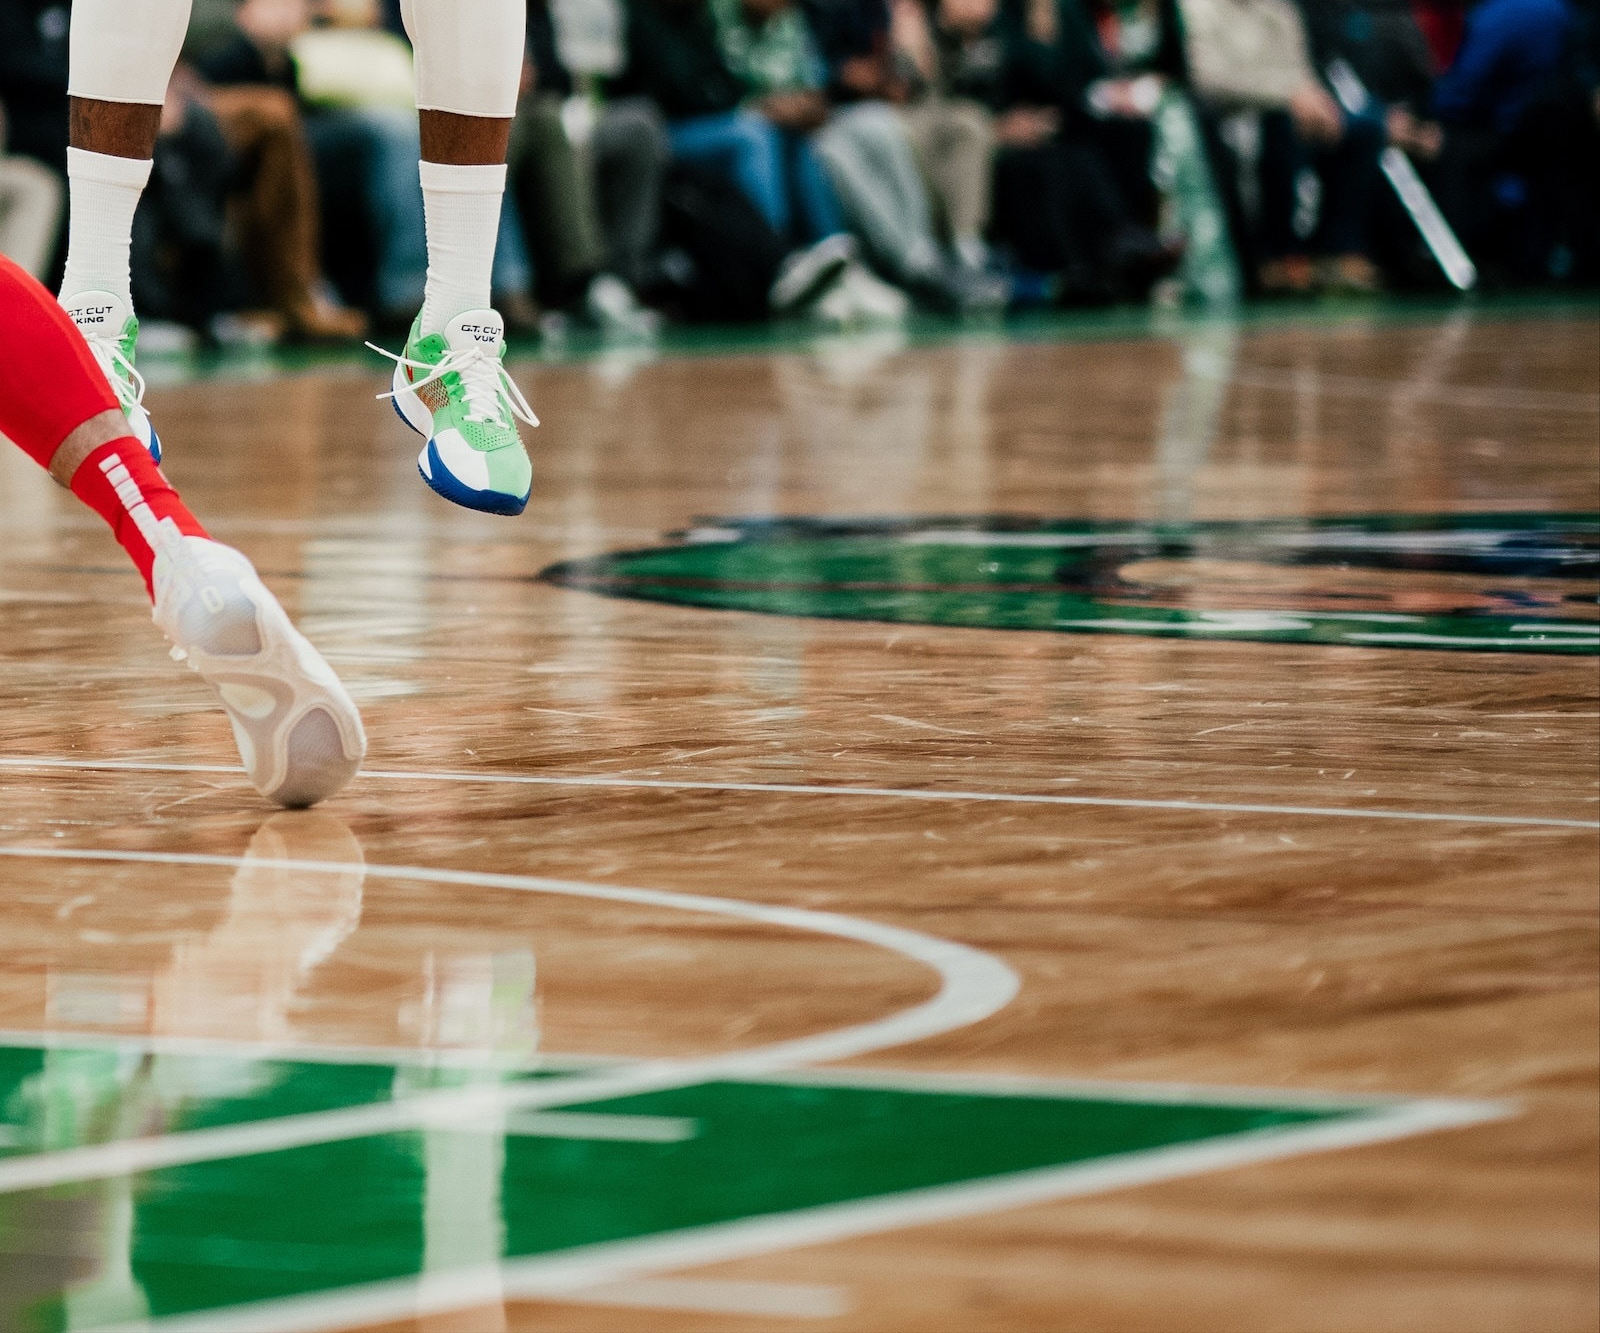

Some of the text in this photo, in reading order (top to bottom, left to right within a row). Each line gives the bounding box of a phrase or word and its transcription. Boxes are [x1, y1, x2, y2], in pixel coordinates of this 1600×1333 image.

[86, 306, 113, 315] CUT
[76, 316, 105, 325] KING
[461, 324, 481, 333] G.T.
[473, 334, 496, 343] VUK
